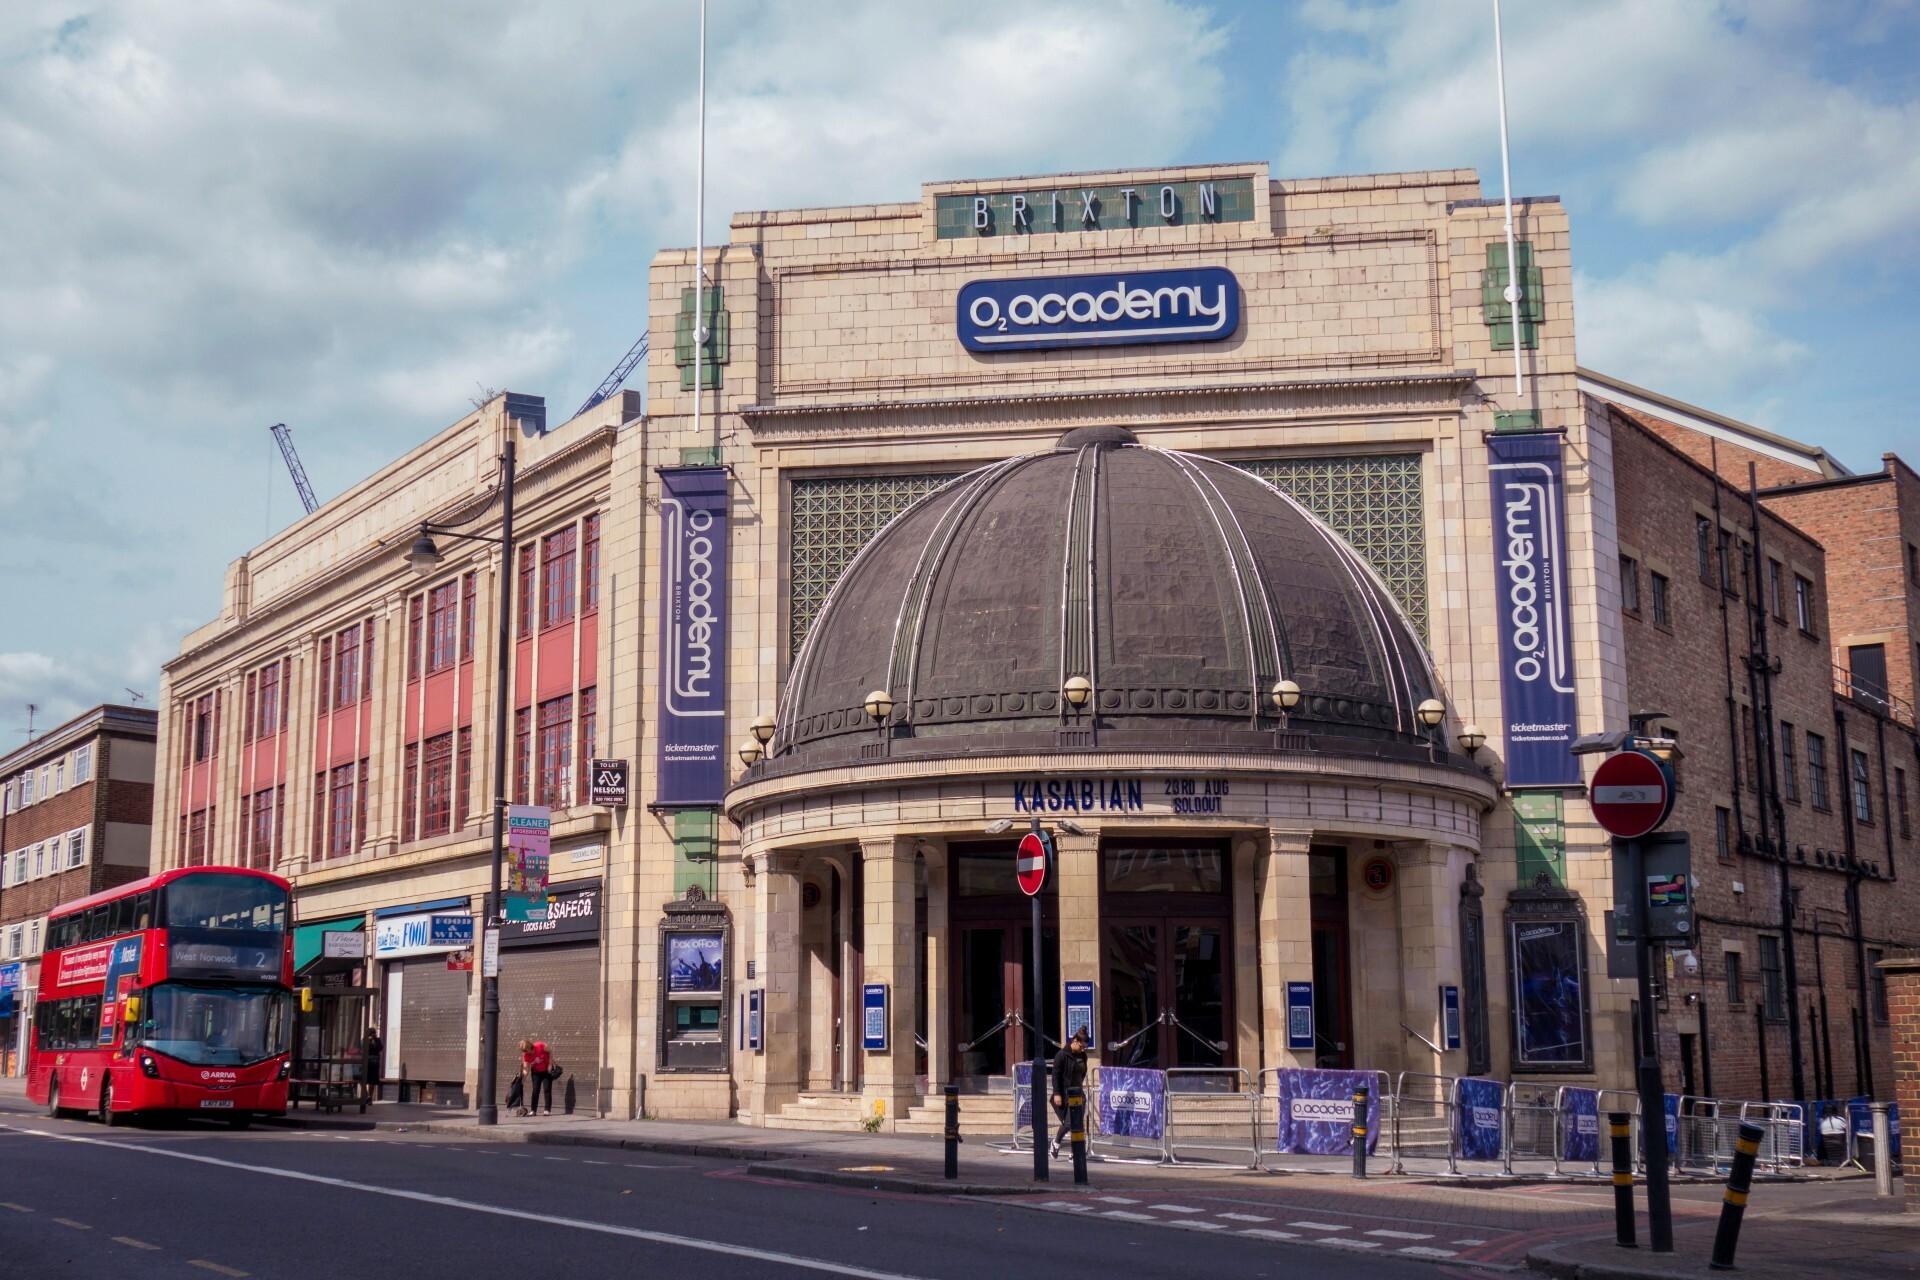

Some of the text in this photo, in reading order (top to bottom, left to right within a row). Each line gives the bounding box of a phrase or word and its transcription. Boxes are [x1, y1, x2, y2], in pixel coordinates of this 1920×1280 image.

[974, 183, 1215, 229] BRIXTON
[1543, 561, 1551, 599] BRIXTON
[1511, 723, 1568, 731] ticketmaster
[665, 744, 716, 752] ticketmaster
[593, 786, 626, 795] NELSONS
[1165, 779, 1229, 795] 23RD AUG
[1014, 778, 1143, 813] KASABIAN
[510, 818, 549, 828] CLEANER
[1526, 902, 1563, 911] ACADEMY
[677, 914, 711, 923] ACADEMY
[523, 922, 538, 932] LOCKS
[543, 920, 556, 929] KEYS
[332, 933, 359, 942] Peter's
[402, 921, 427, 947] FOOD
[672, 939, 718, 948] box office
[175, 952, 237, 963] West Norwood
[255, 951, 265, 968] 2
